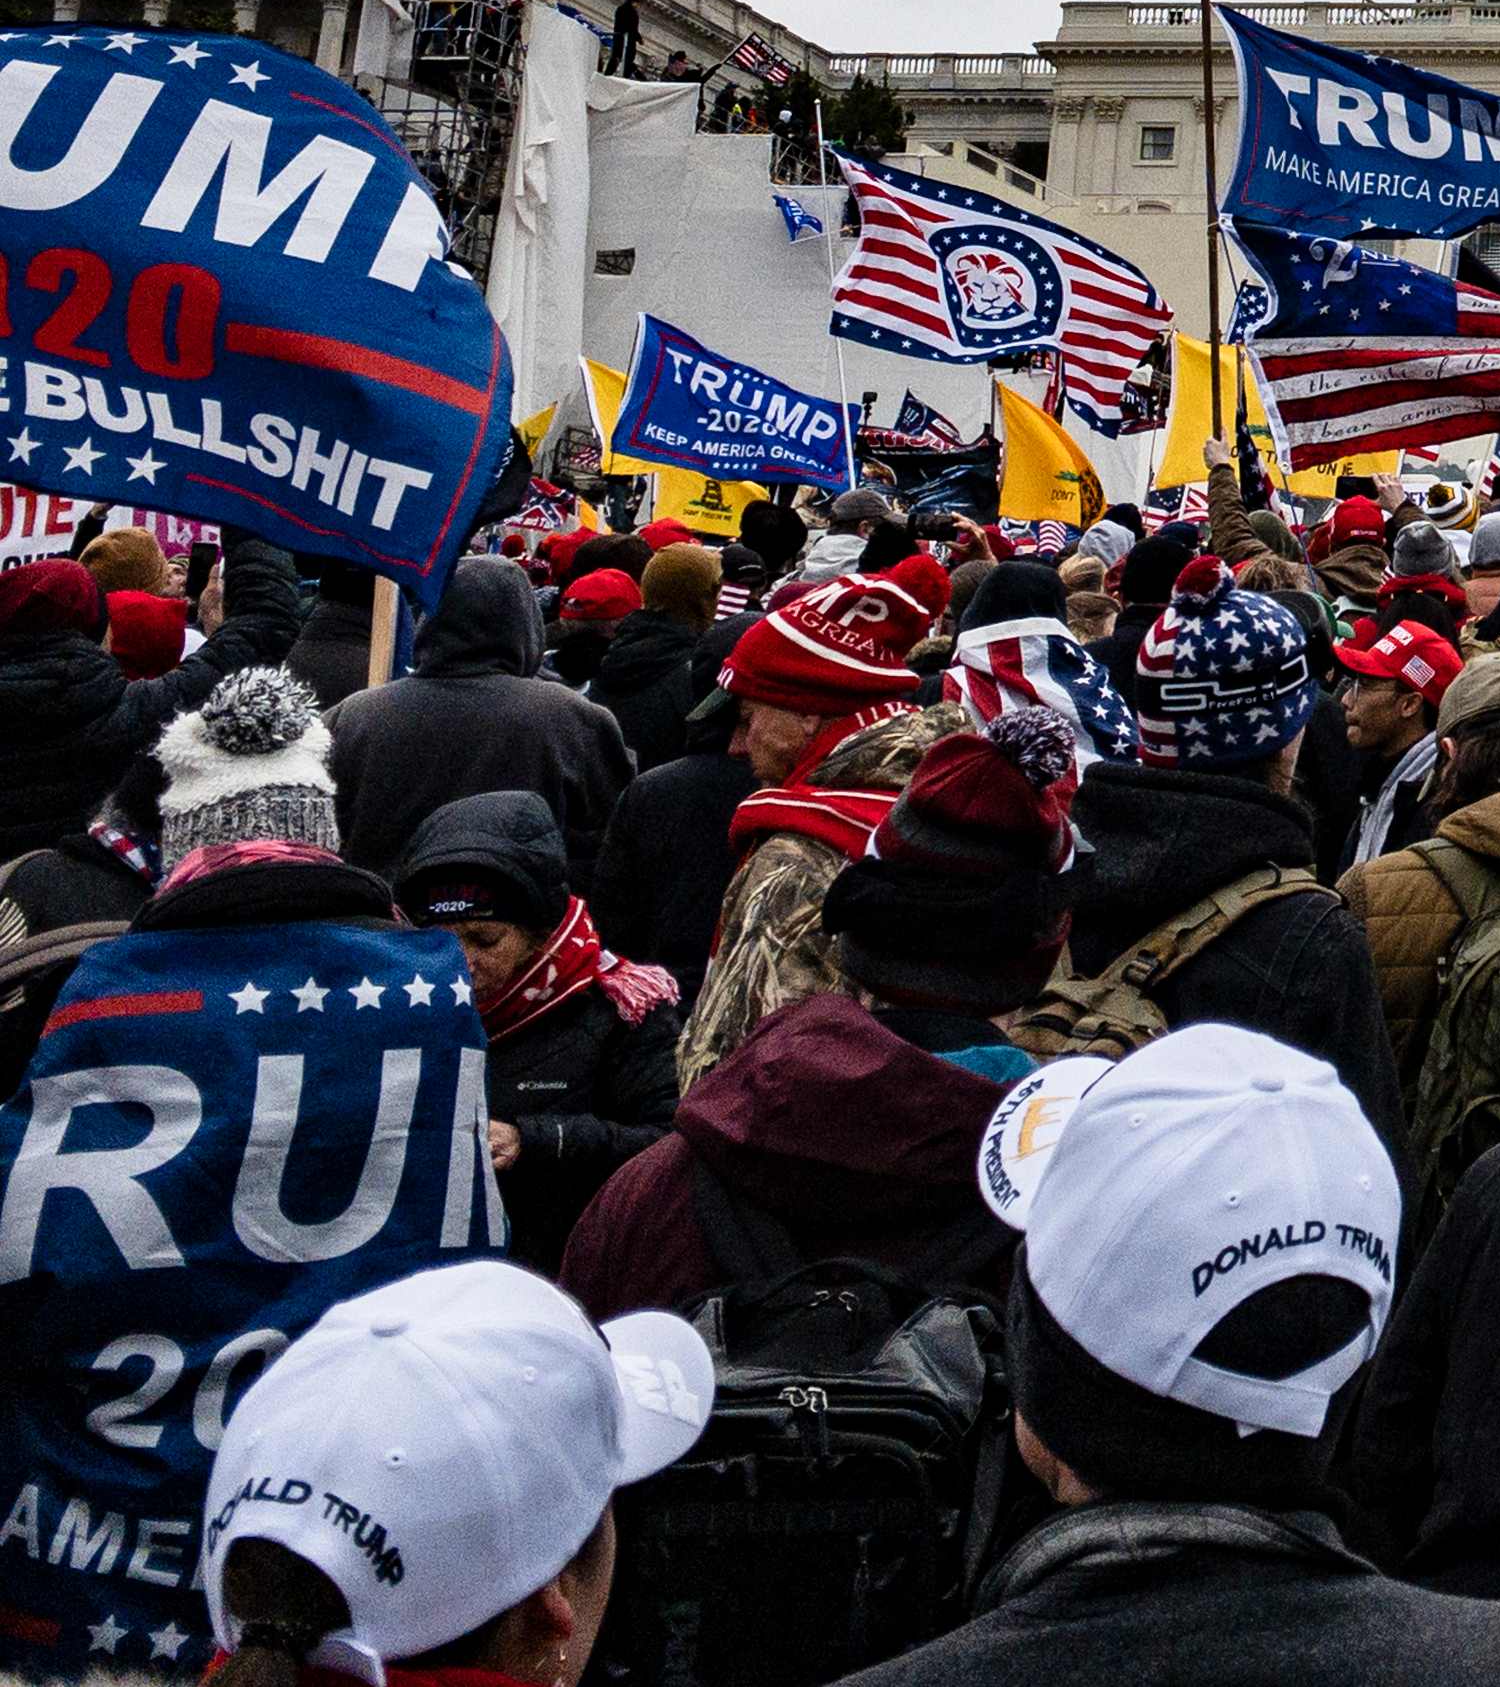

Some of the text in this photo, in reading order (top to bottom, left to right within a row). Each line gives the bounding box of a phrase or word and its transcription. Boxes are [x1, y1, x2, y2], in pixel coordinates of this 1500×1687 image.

[1265, 145, 1322, 187] MAKE
[1325, 168, 1432, 204] AMERICA
[666, 347, 837, 446] TRUMP
[1321, 421, 1373, 439] bear
[23, 360, 434, 532] BULLSHIT
[645, 423, 688, 447] KEEP
[692, 439, 766, 458] AMERICA
[982, 1130, 1020, 1211] PRESIDENT
[1191, 1220, 1327, 1298] DONALD
[322, 1491, 405, 1588] TRUMP
